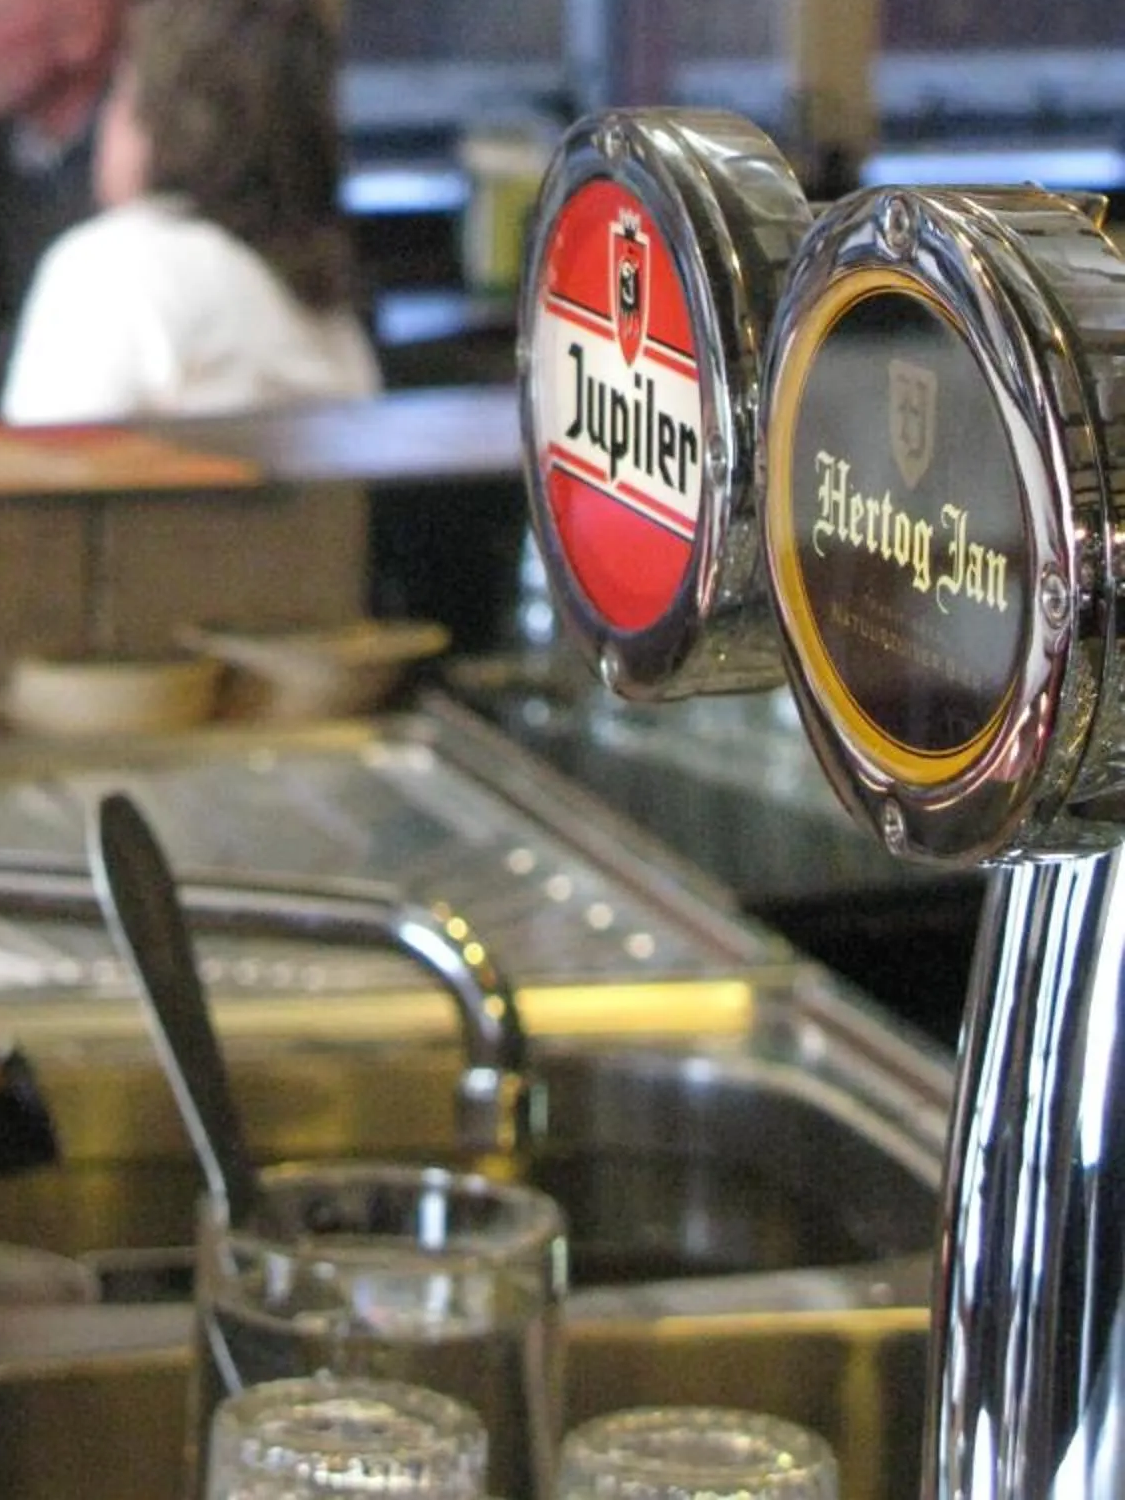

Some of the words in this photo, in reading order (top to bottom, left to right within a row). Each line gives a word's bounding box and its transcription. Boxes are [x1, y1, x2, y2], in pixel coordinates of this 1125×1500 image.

[565, 342, 698, 495] Jupiler
[812, 450, 933, 593] Hertog
[936, 503, 1009, 615] Jan
